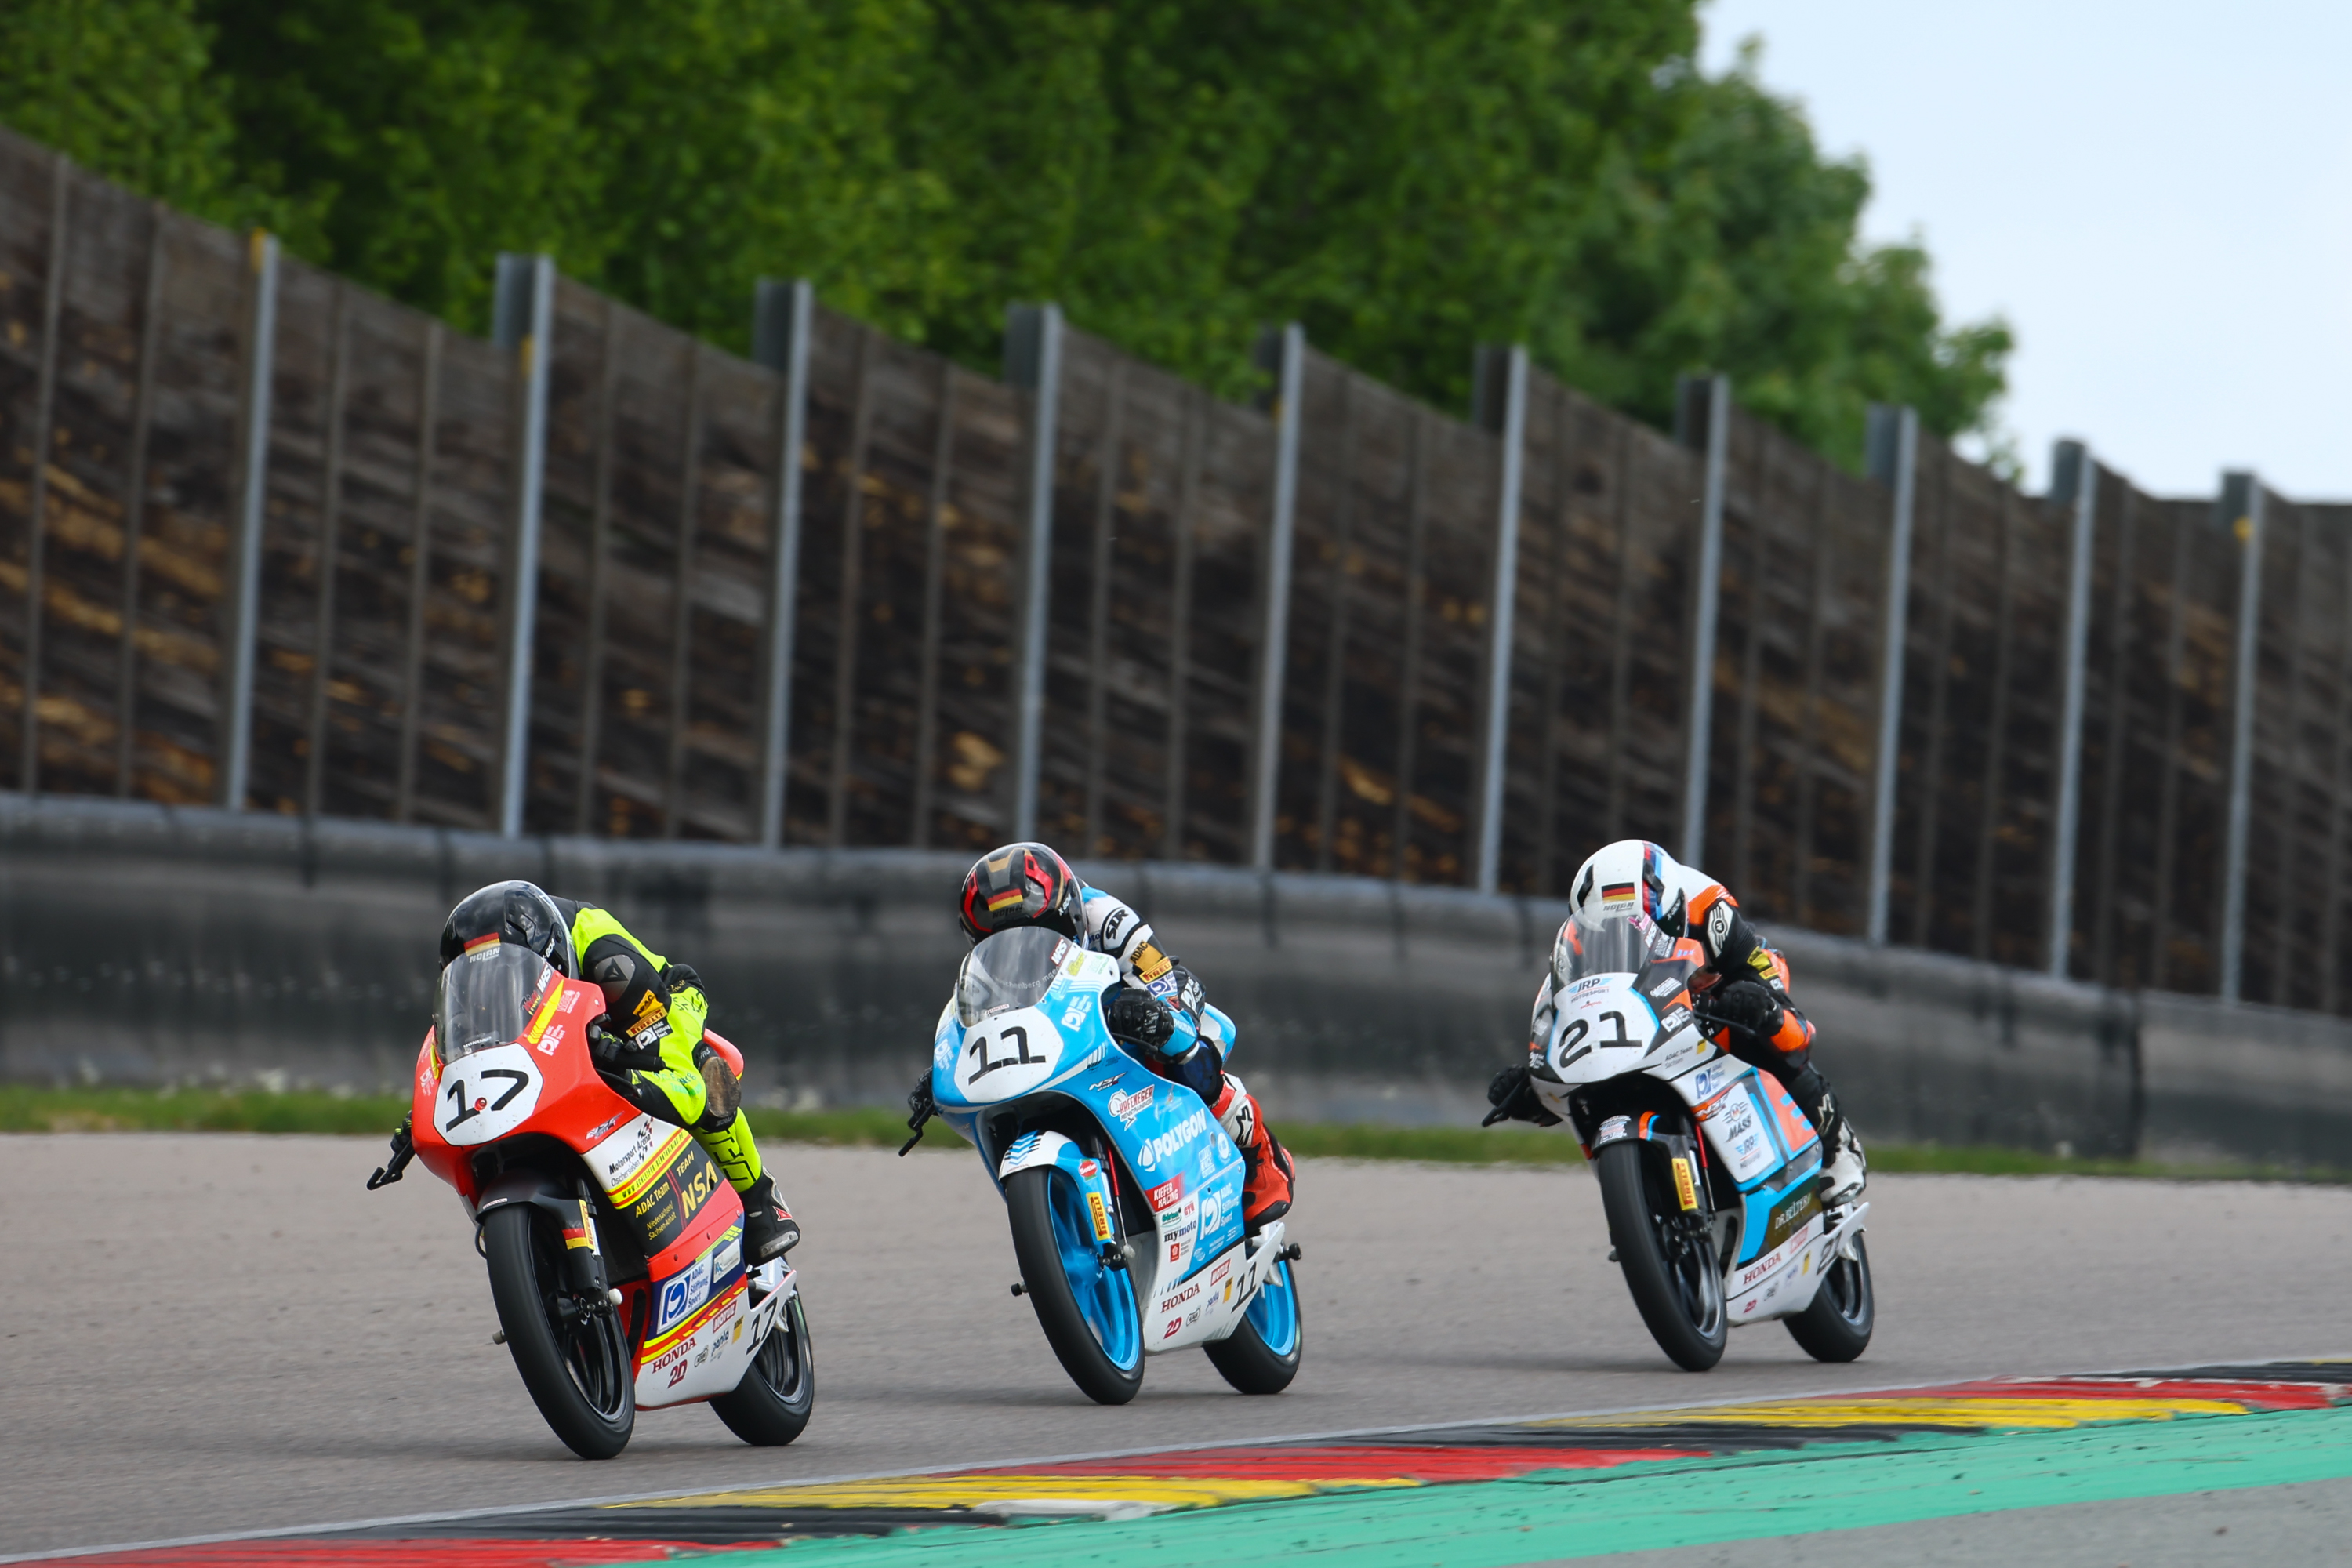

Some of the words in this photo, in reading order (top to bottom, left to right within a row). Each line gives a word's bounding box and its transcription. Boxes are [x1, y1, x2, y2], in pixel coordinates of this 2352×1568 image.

[1603, 902, 1635, 913] NOLAN
[469, 947, 500, 963] NOLAN
[1131, 941, 1149, 964] ADAC
[630, 1009, 664, 1035] PIRELLI
[1559, 1011, 1642, 1069] 21
[968, 1025, 1047, 1086] 11
[446, 1069, 529, 1133] 17
[1120, 1085, 1154, 1114] HAFENEGER
[1152, 1107, 1207, 1163] POLYGON
[1725, 1115, 1752, 1143] MASS
[609, 1145, 637, 1175] Motorsport
[637, 1134, 651, 1150] Arena
[676, 1150, 695, 1177] TEAM
[611, 1159, 641, 1187] Oschersleben
[636, 1195, 655, 1218] ADAC
[653, 1181, 670, 1202] Team
[681, 1160, 718, 1219] NSA
[1153, 1182, 1173, 1201] KIEFER
[1158, 1189, 1179, 1209] RACING
[1091, 1196, 1108, 1236] PIRELLI
[1164, 1220, 1197, 1243] mymoto
[691, 1264, 705, 1280] ADAC
[1743, 1252, 1782, 1285] HONDA
[688, 1292, 702, 1308] Sport
[690, 1276, 709, 1295] Stiftung
[1160, 1283, 1200, 1314] HONDA
[1231, 1261, 1257, 1314] 11
[746, 1296, 778, 1356] 17
[652, 1337, 697, 1374] HONDA
